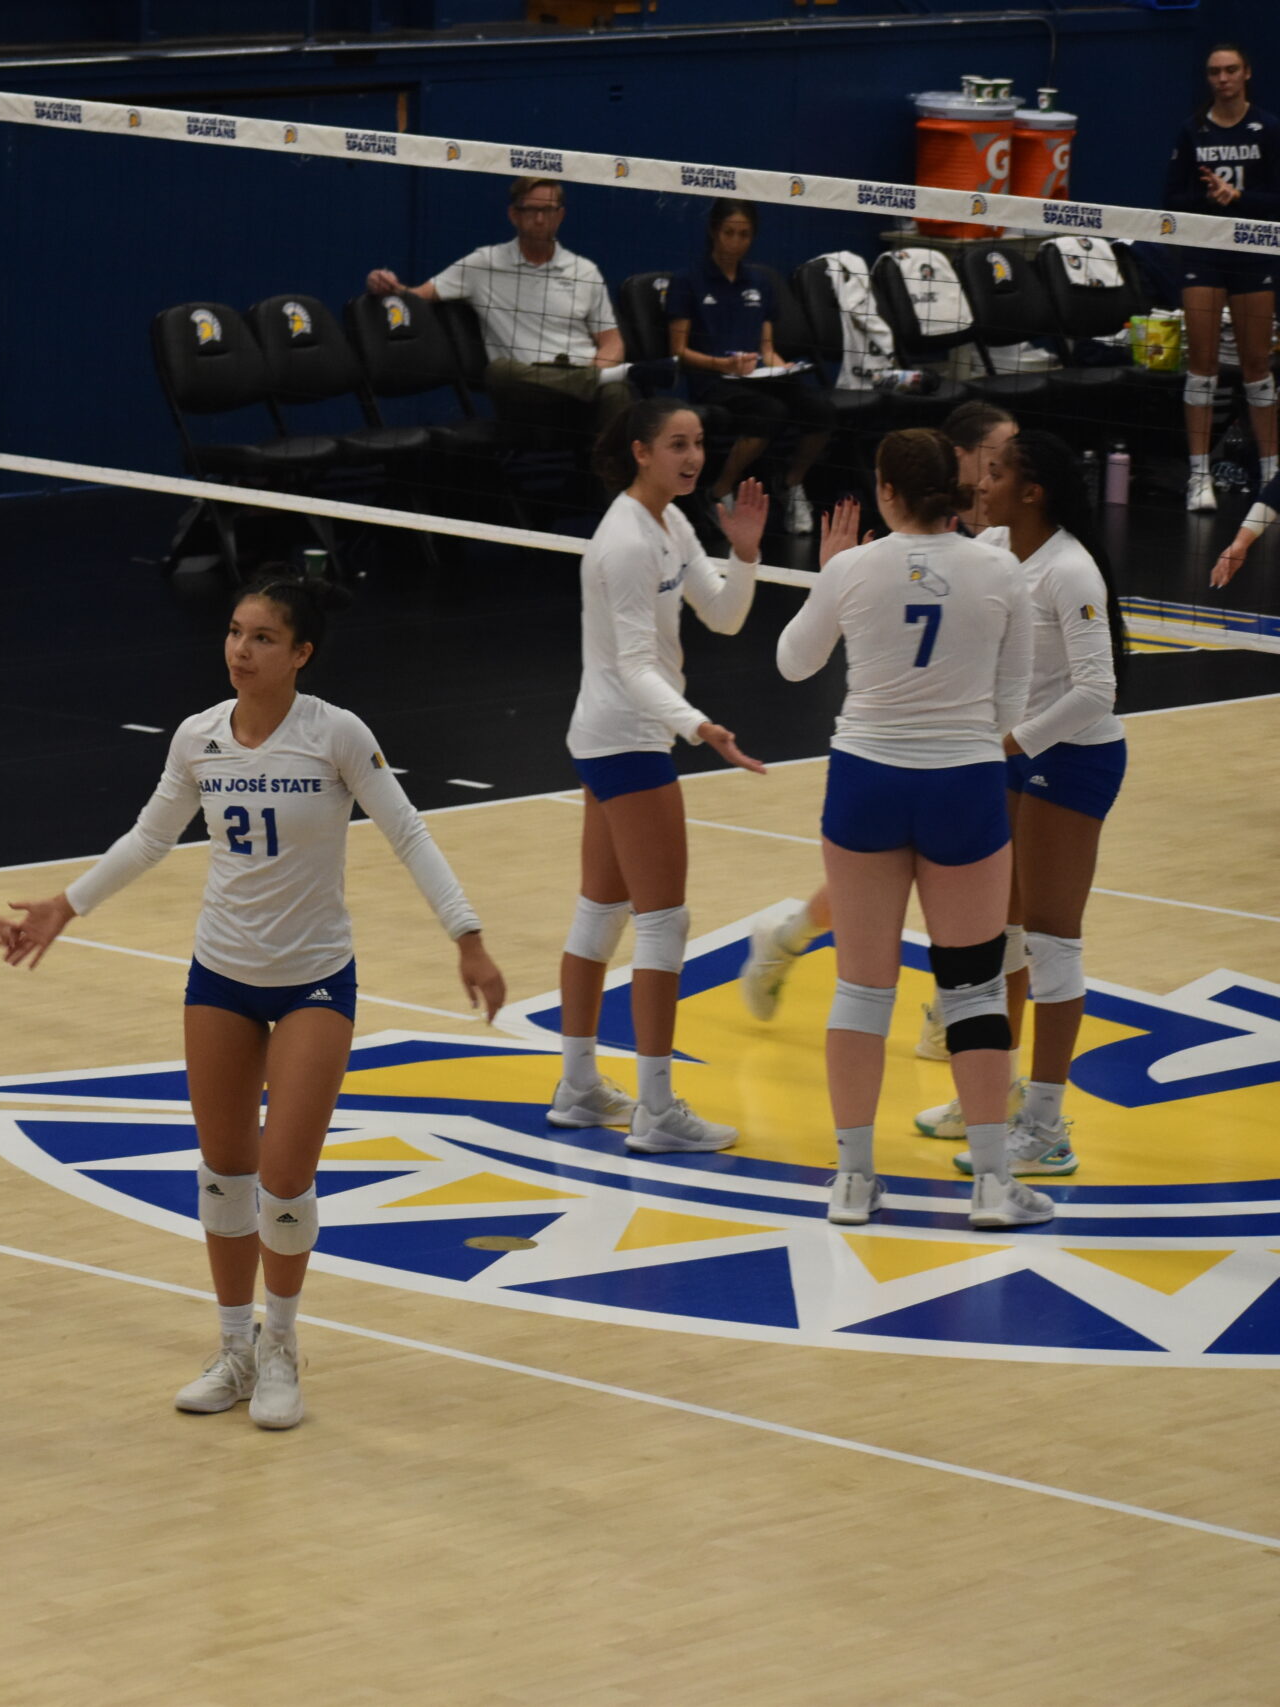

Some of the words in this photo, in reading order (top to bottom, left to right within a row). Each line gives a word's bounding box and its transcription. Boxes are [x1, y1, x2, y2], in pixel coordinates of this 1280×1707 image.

[1196, 144, 1261, 162] NEVADA
[510, 157, 563, 172] SPARTANS
[681, 175, 736, 190] SPARTANS
[857, 193, 916, 209] SPARTANS
[1043, 211, 1103, 229] SPARTANS
[904, 604, 942, 668] 7
[225, 773, 267, 793] JOSÉ
[271, 778, 322, 793] STATE
[224, 805, 278, 857] 21
